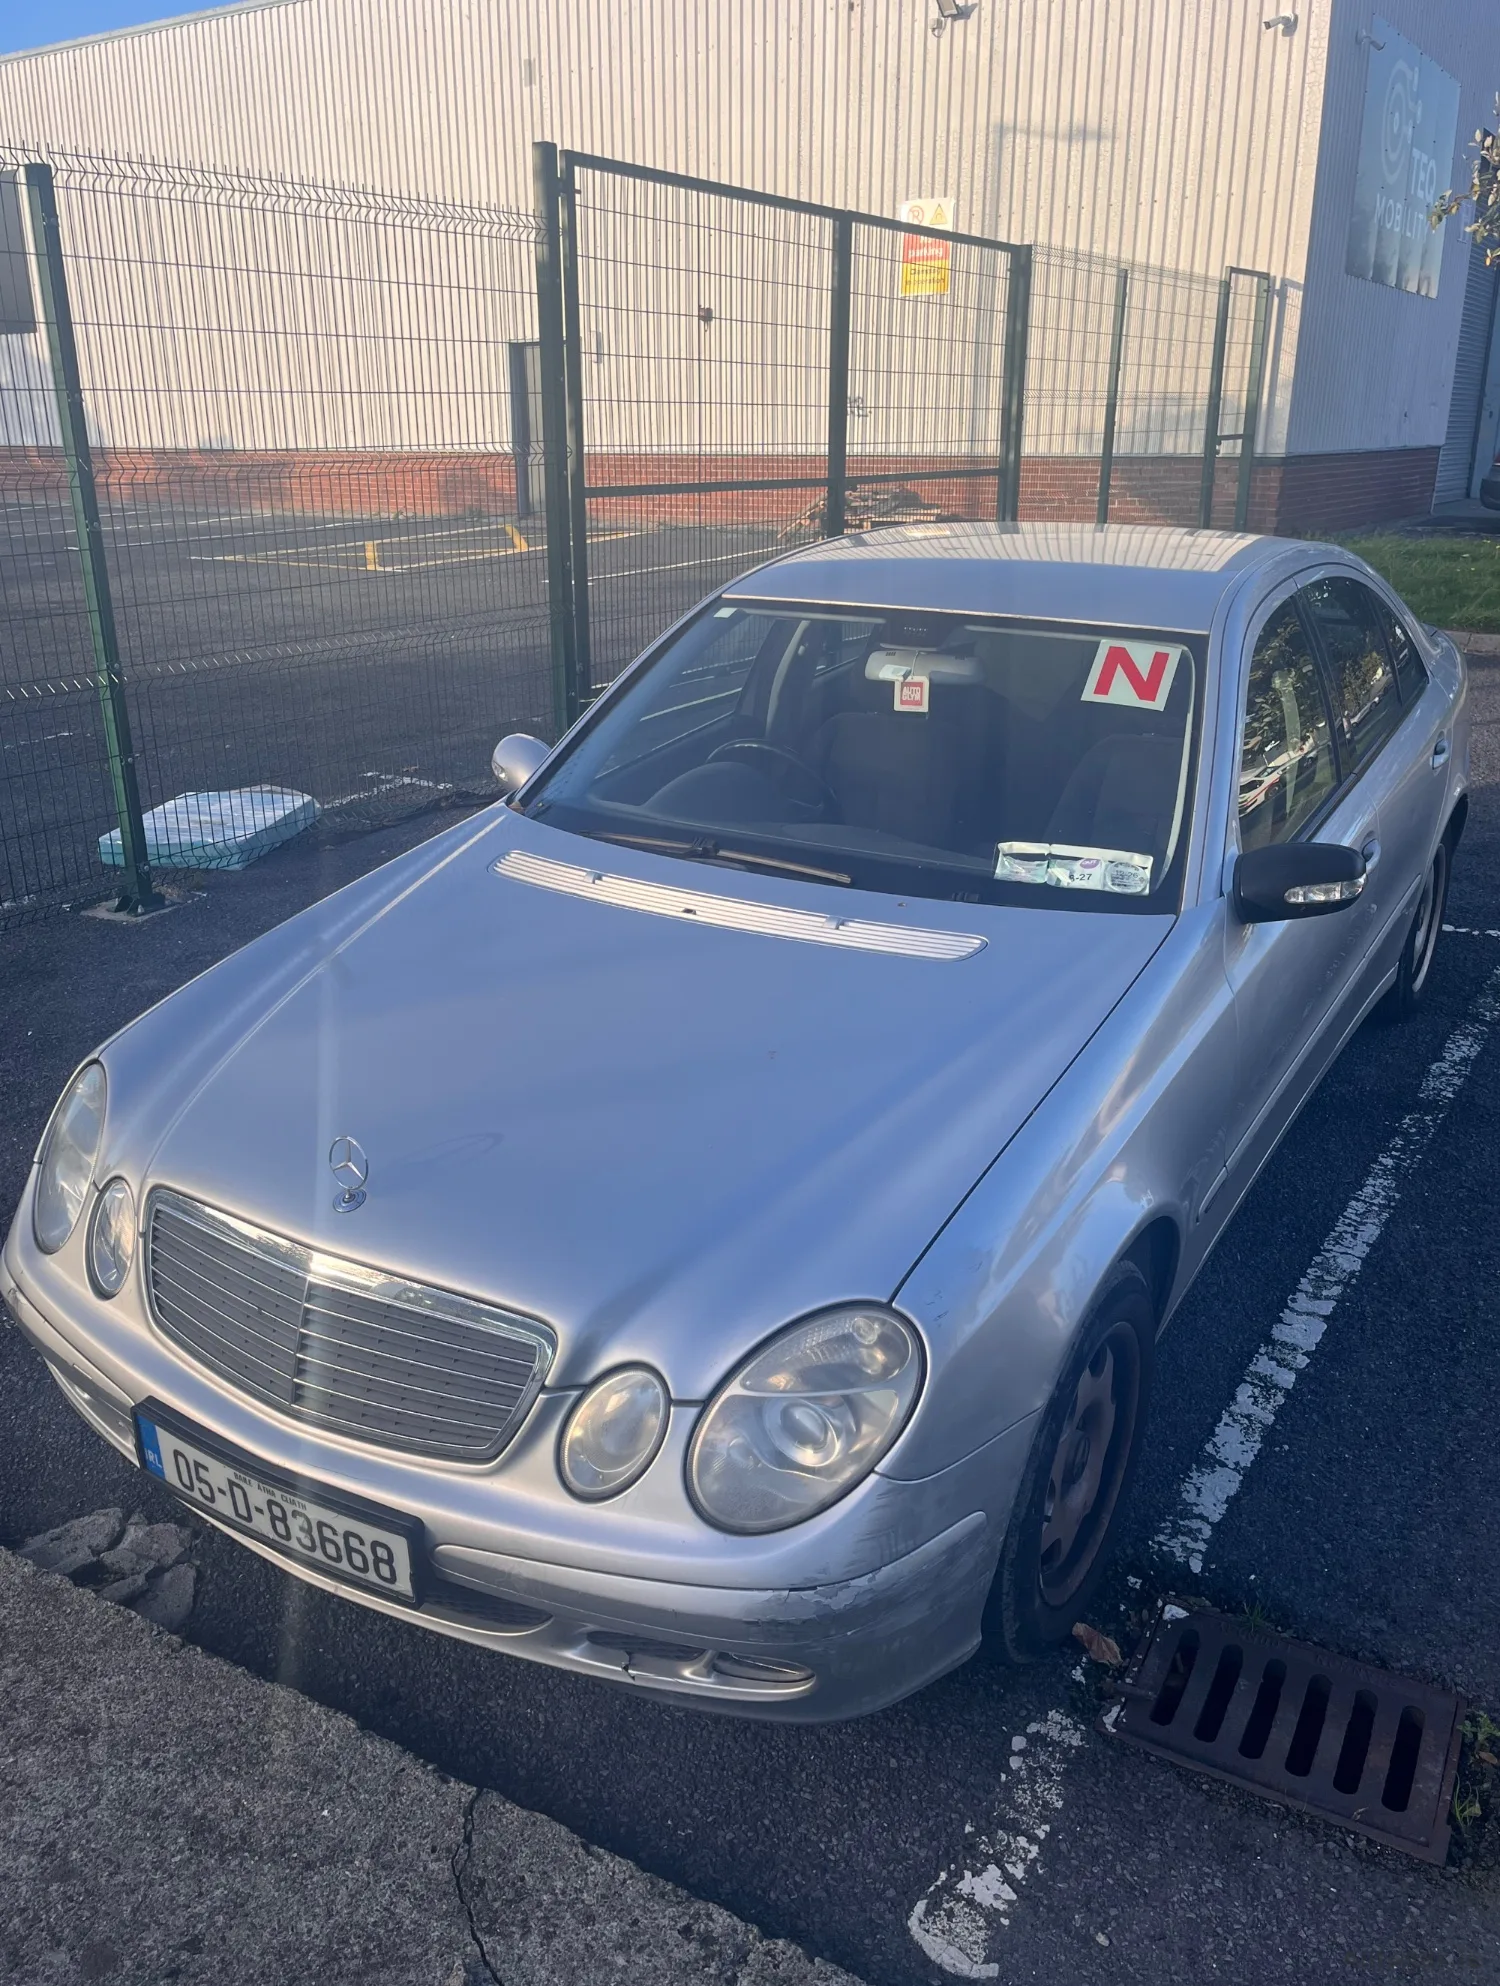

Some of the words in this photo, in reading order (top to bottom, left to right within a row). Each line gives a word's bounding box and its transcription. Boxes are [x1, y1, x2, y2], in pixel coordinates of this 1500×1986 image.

[1410, 147, 1437, 204] TEQ
[907, 247, 943, 259] parking
[903, 686, 921, 694] AUTO
[1093, 645, 1170, 703] N
[144, 1450, 162, 1469] IRL
[172, 1448, 397, 1586] 05-D-83668
